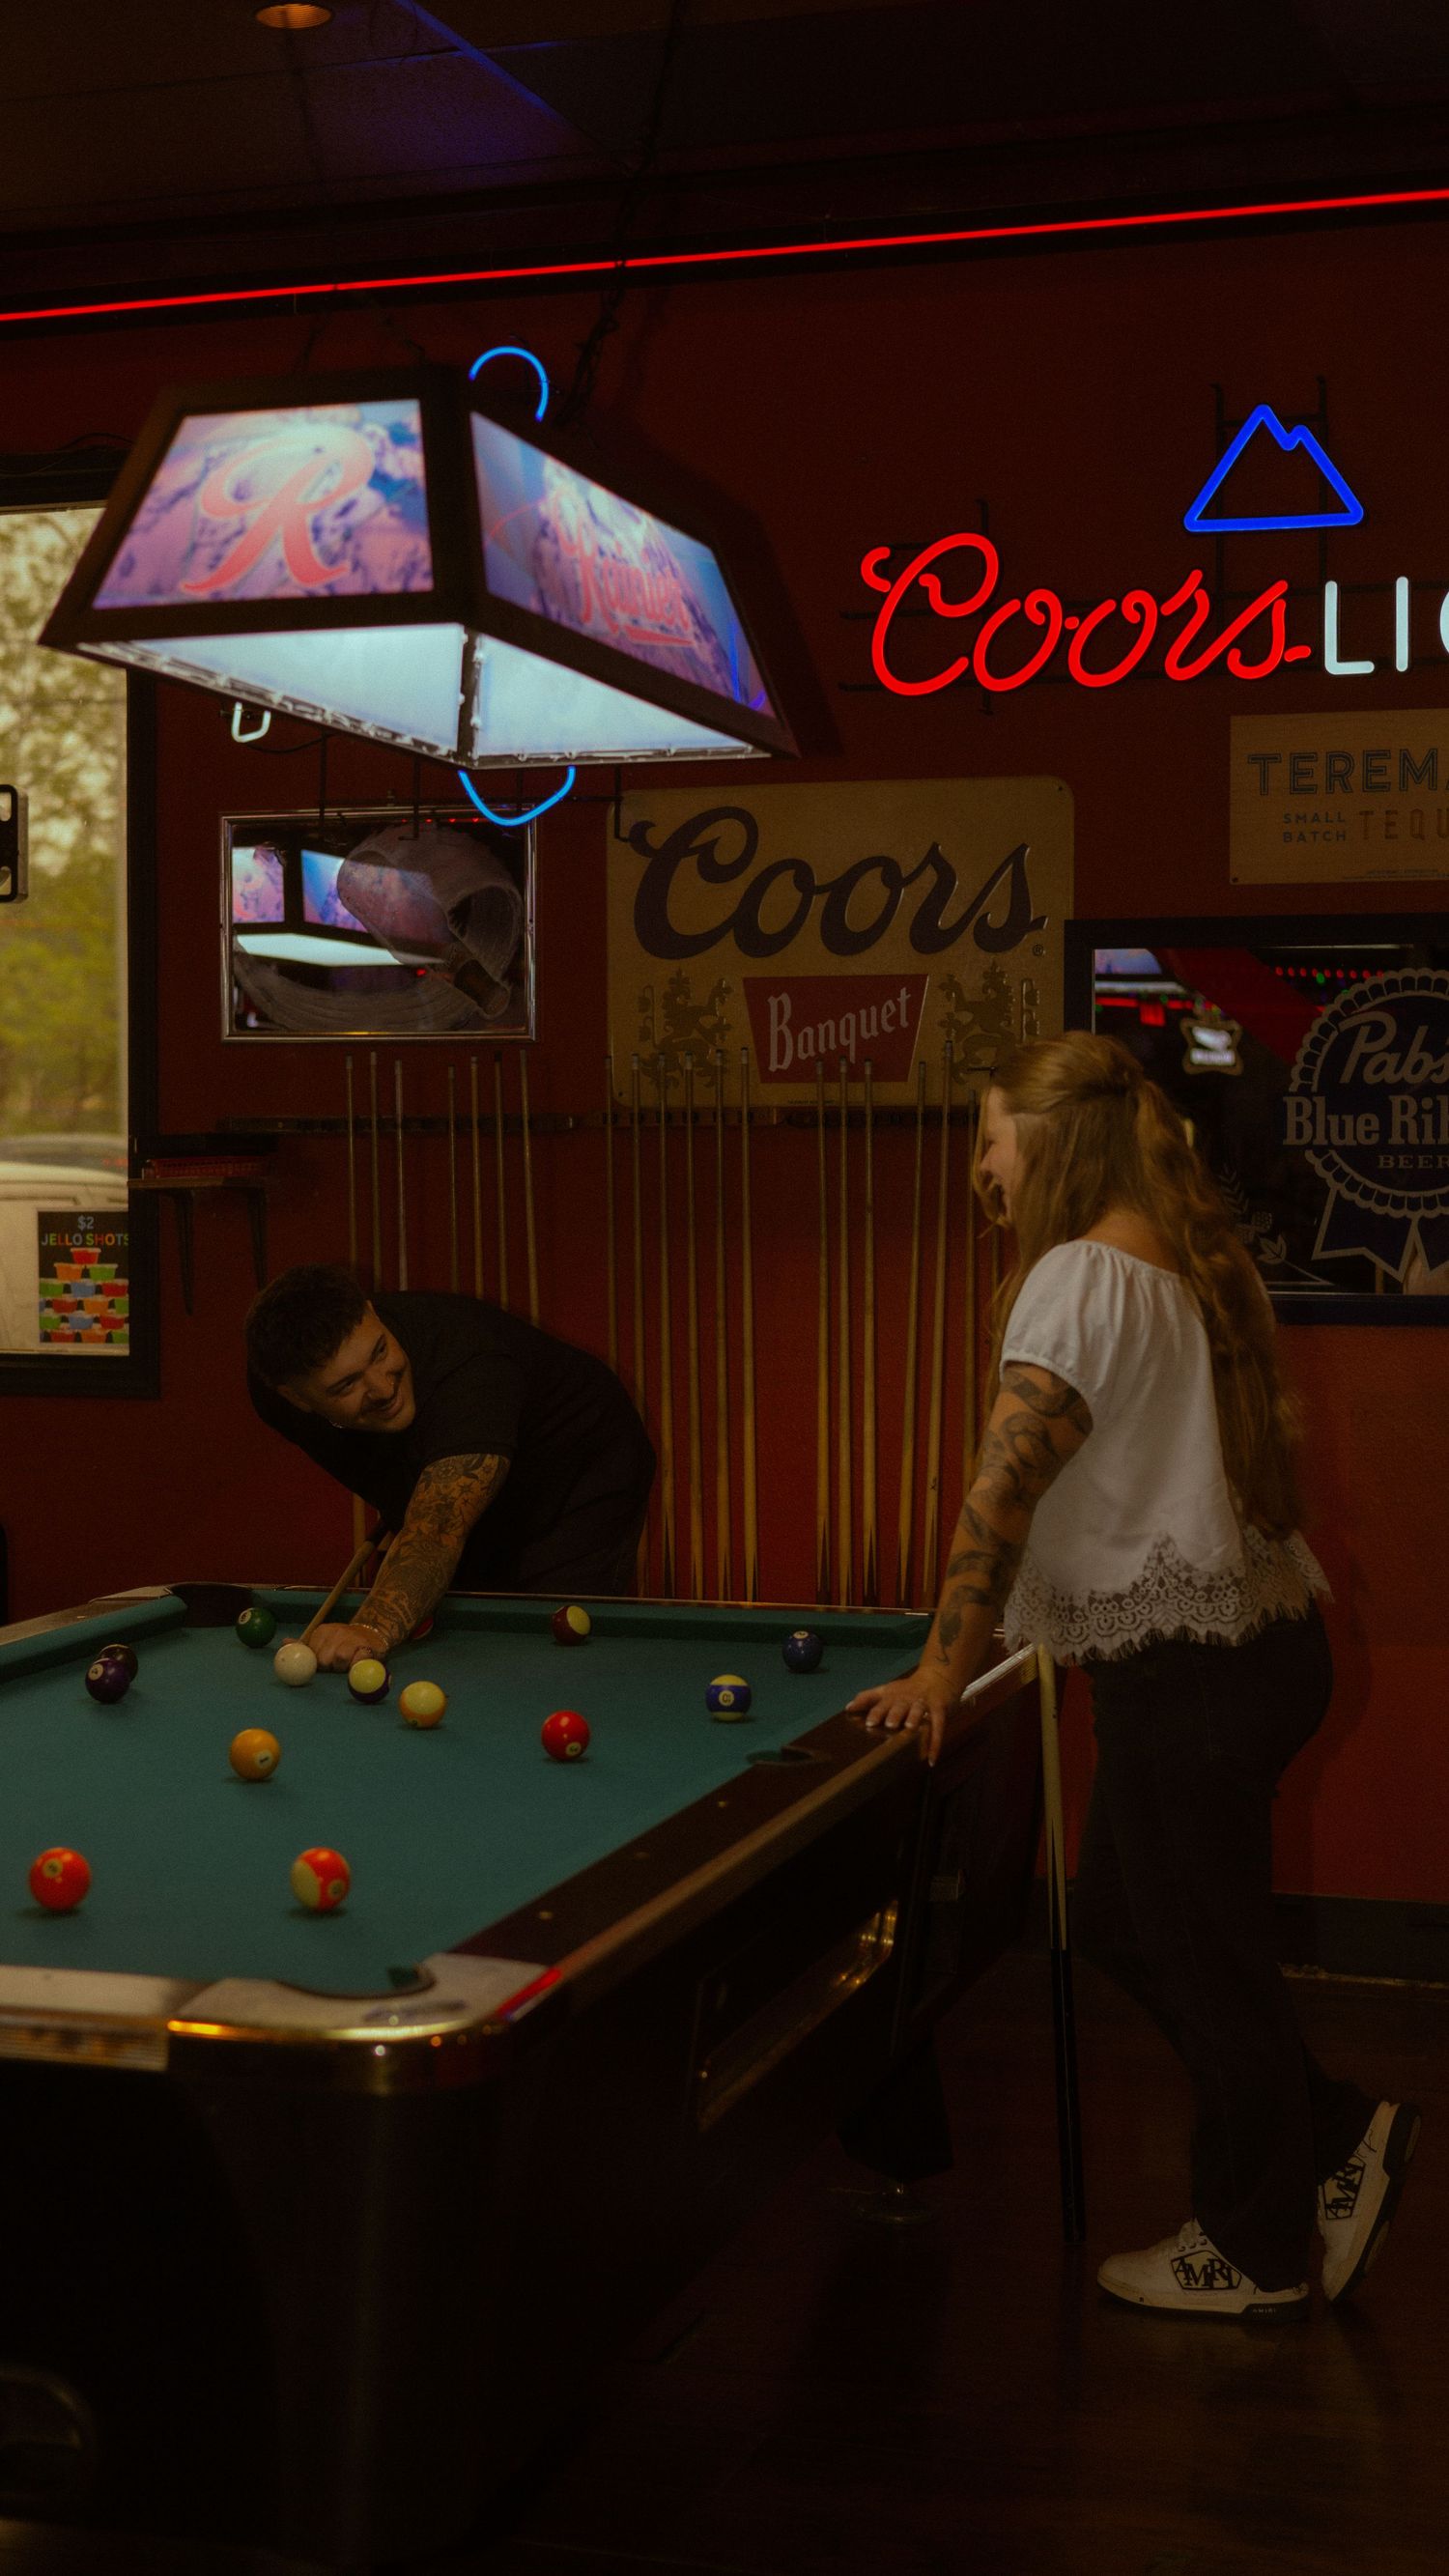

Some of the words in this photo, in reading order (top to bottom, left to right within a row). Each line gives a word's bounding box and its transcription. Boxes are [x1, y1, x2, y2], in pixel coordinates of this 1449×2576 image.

[180, 422, 375, 593] R
[861, 531, 1312, 696] Coors
[1324, 576, 1449, 675] LI
[1247, 748, 1449, 796] TEREM
[1283, 811, 1346, 825] SMALL
[1283, 831, 1347, 843] BATCH
[628, 806, 1049, 960] Coors
[767, 987, 912, 1073] Banquet
[1282, 1096, 1380, 1146] Blue
[1378, 1154, 1449, 1169] BEER
[42, 1232, 83, 1247] JELLO
[76, 1215, 95, 1231] $2
